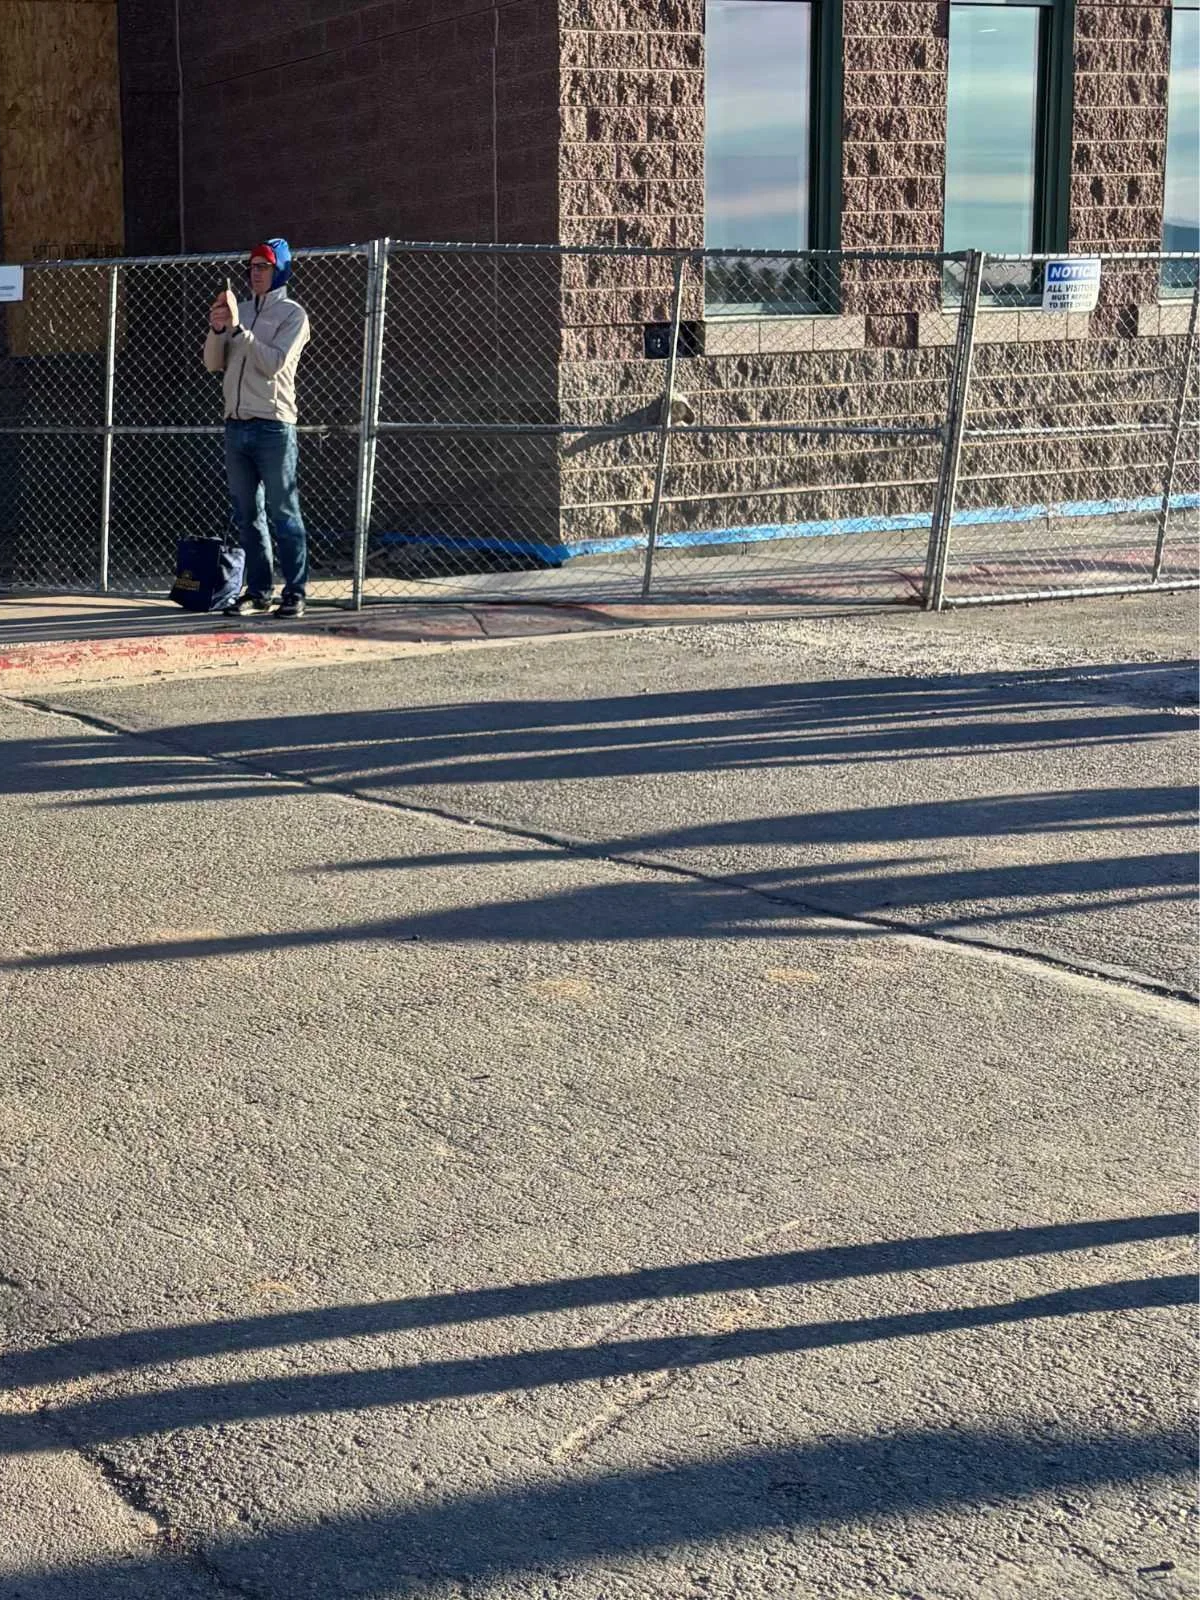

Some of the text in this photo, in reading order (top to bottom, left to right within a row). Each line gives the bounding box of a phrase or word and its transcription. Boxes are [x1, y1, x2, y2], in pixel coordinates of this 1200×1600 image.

[1047, 283, 1062, 293] ALL
[1051, 293, 1070, 301] MUST
[1049, 301, 1058, 309] TO
